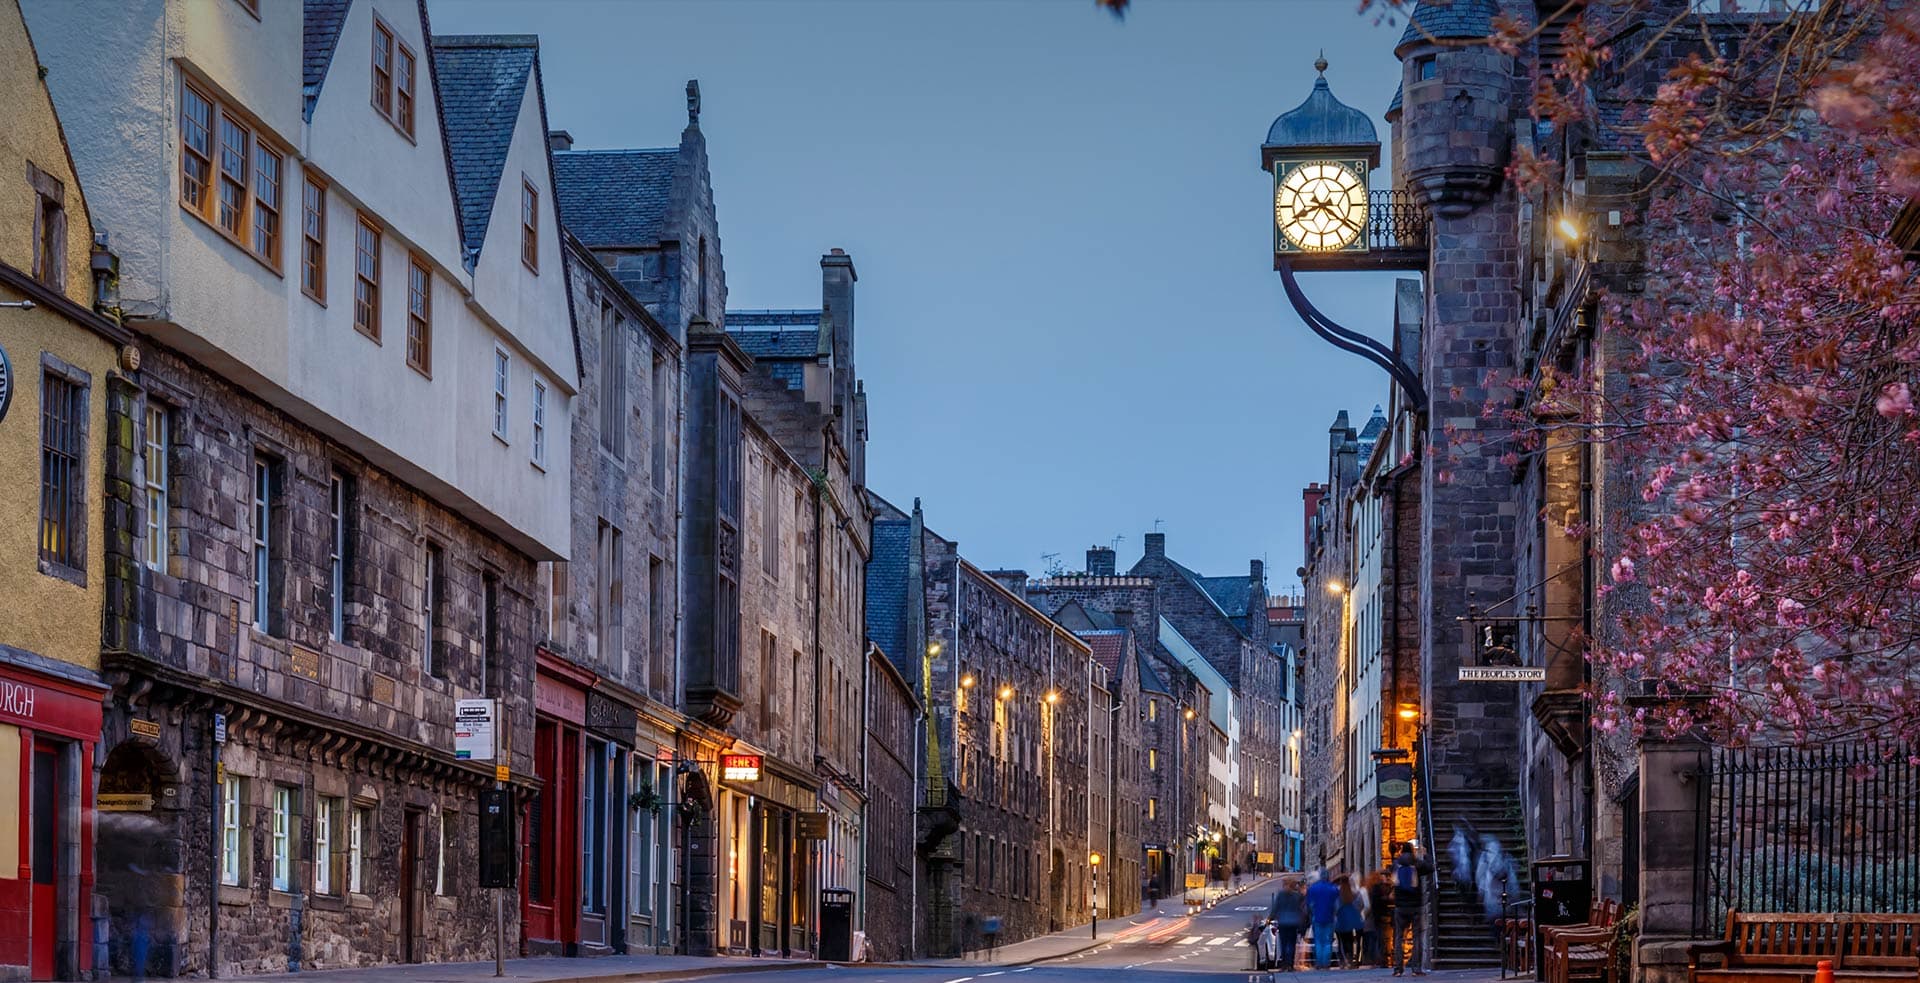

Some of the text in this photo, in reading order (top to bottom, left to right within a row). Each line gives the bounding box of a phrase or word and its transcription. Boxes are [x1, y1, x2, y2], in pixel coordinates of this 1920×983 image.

[1280, 161, 1364, 176] 1 8
[1279, 236, 1364, 251] 8 4
[1462, 670, 1543, 678] THE PEOPLE'S STORY
[725, 756, 759, 768] BENE'S
